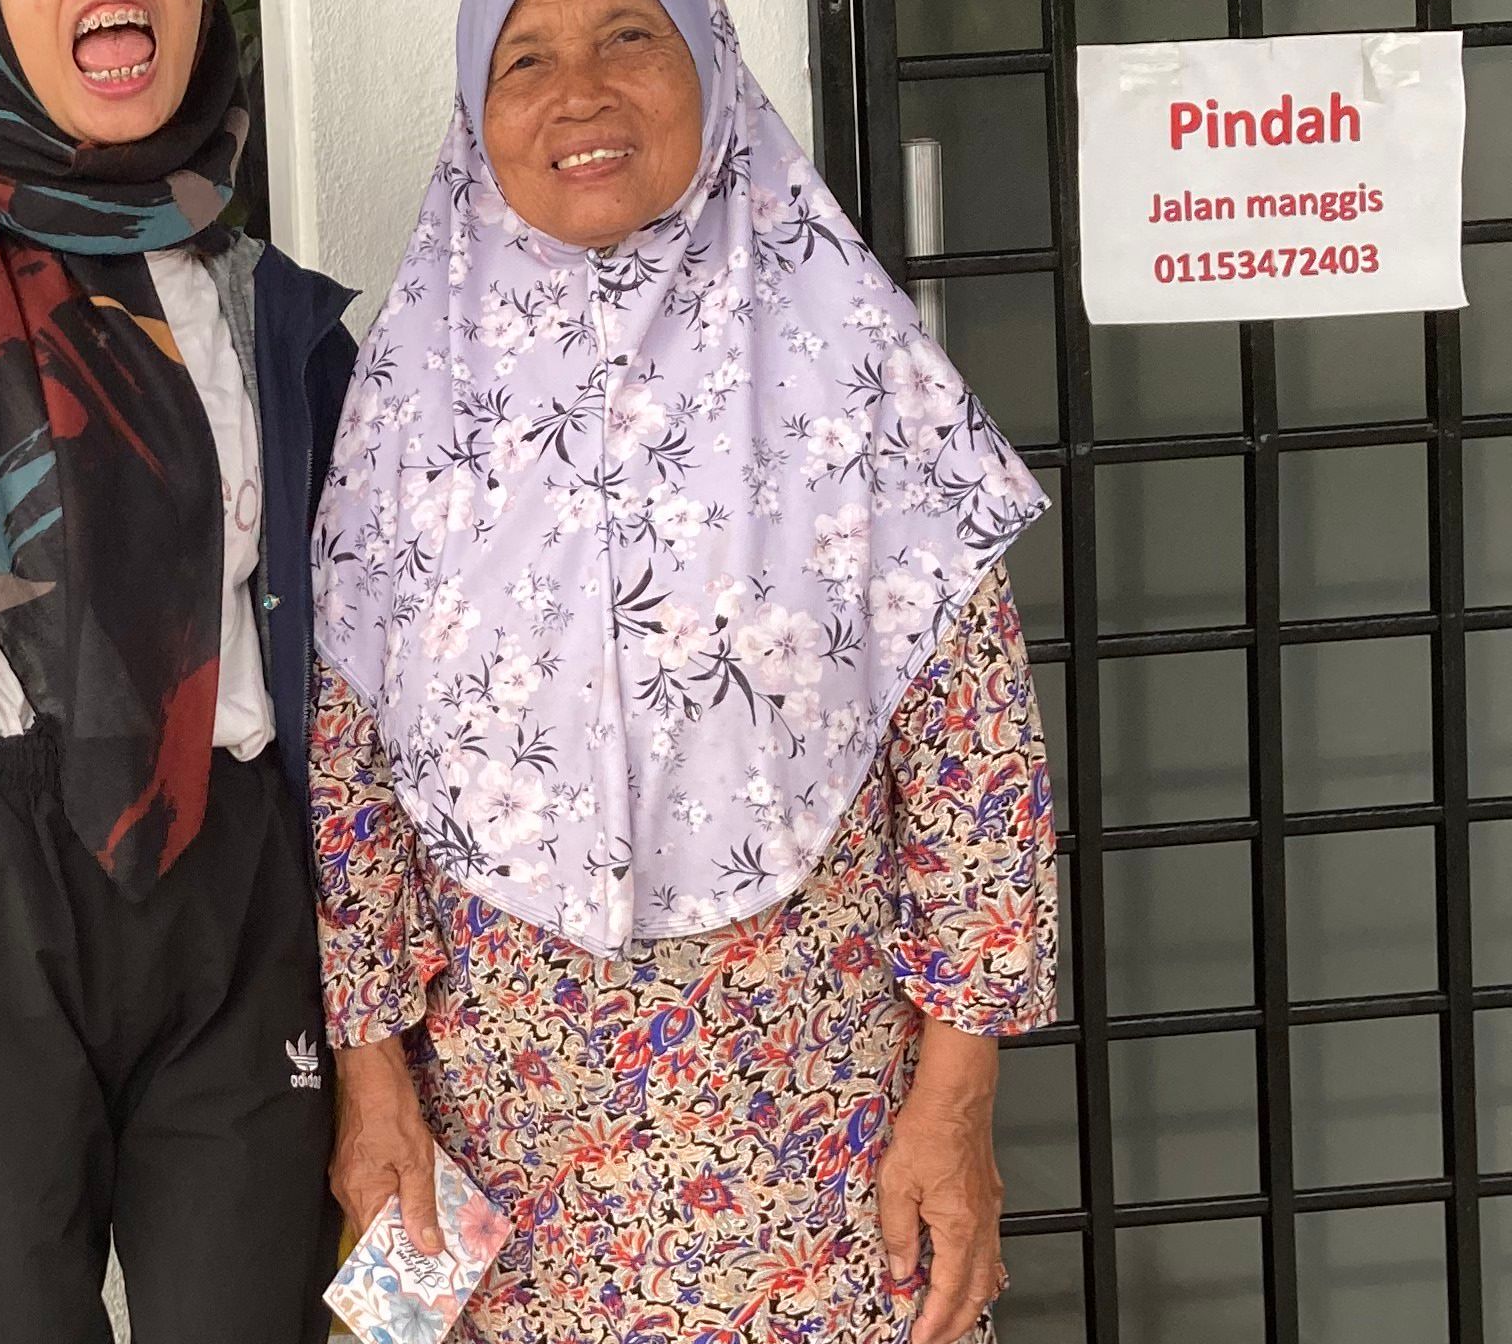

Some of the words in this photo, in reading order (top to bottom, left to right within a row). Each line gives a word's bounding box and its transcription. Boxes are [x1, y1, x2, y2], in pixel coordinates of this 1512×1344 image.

[1170, 92, 1361, 150] Pindah
[1149, 190, 1235, 223] Jalan
[1247, 183, 1384, 223] manggis
[1154, 244, 1380, 283] 01153472403
